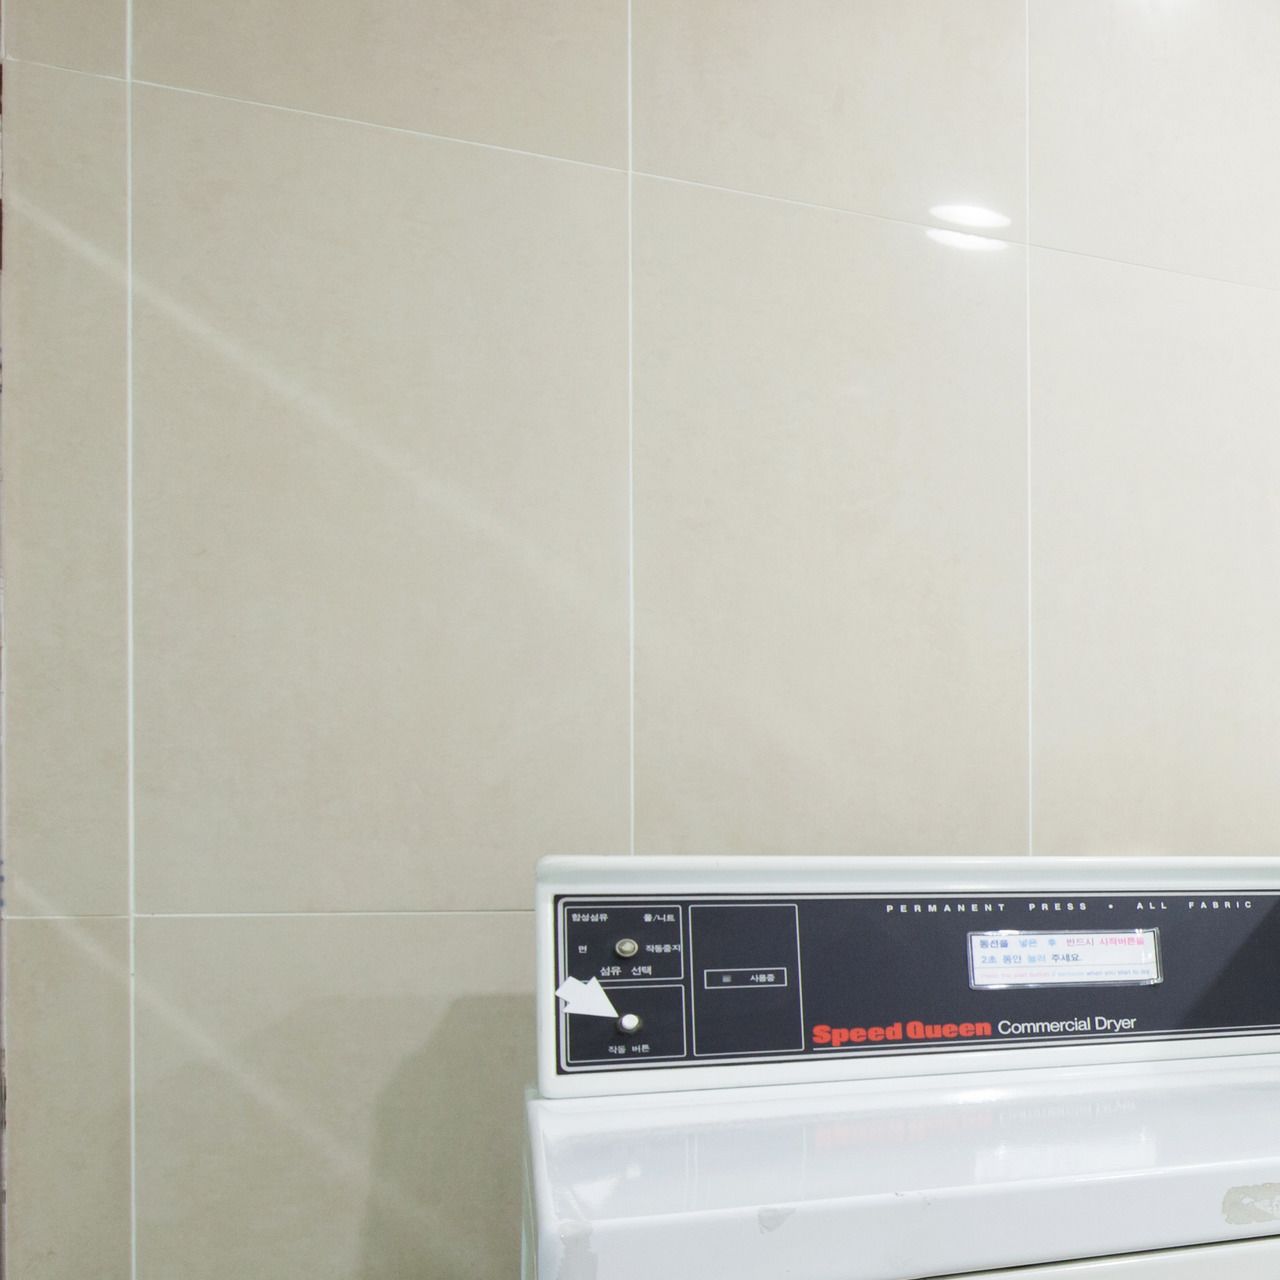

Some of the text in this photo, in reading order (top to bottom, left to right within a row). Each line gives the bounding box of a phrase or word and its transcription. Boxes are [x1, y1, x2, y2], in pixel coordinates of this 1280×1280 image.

[887, 900, 1254, 914] PERMANENT PRESS ALL FABRIC
[570, 911, 609, 924] 합성섬유
[645, 943, 682, 955] 작동중지
[600, 964, 653, 977] 섬유 선택
[750, 973, 776, 984] 사용중
[811, 1015, 1137, 1047] Speed Queen Commercial Dryer
[608, 1042, 651, 1055] 작동 버튼
